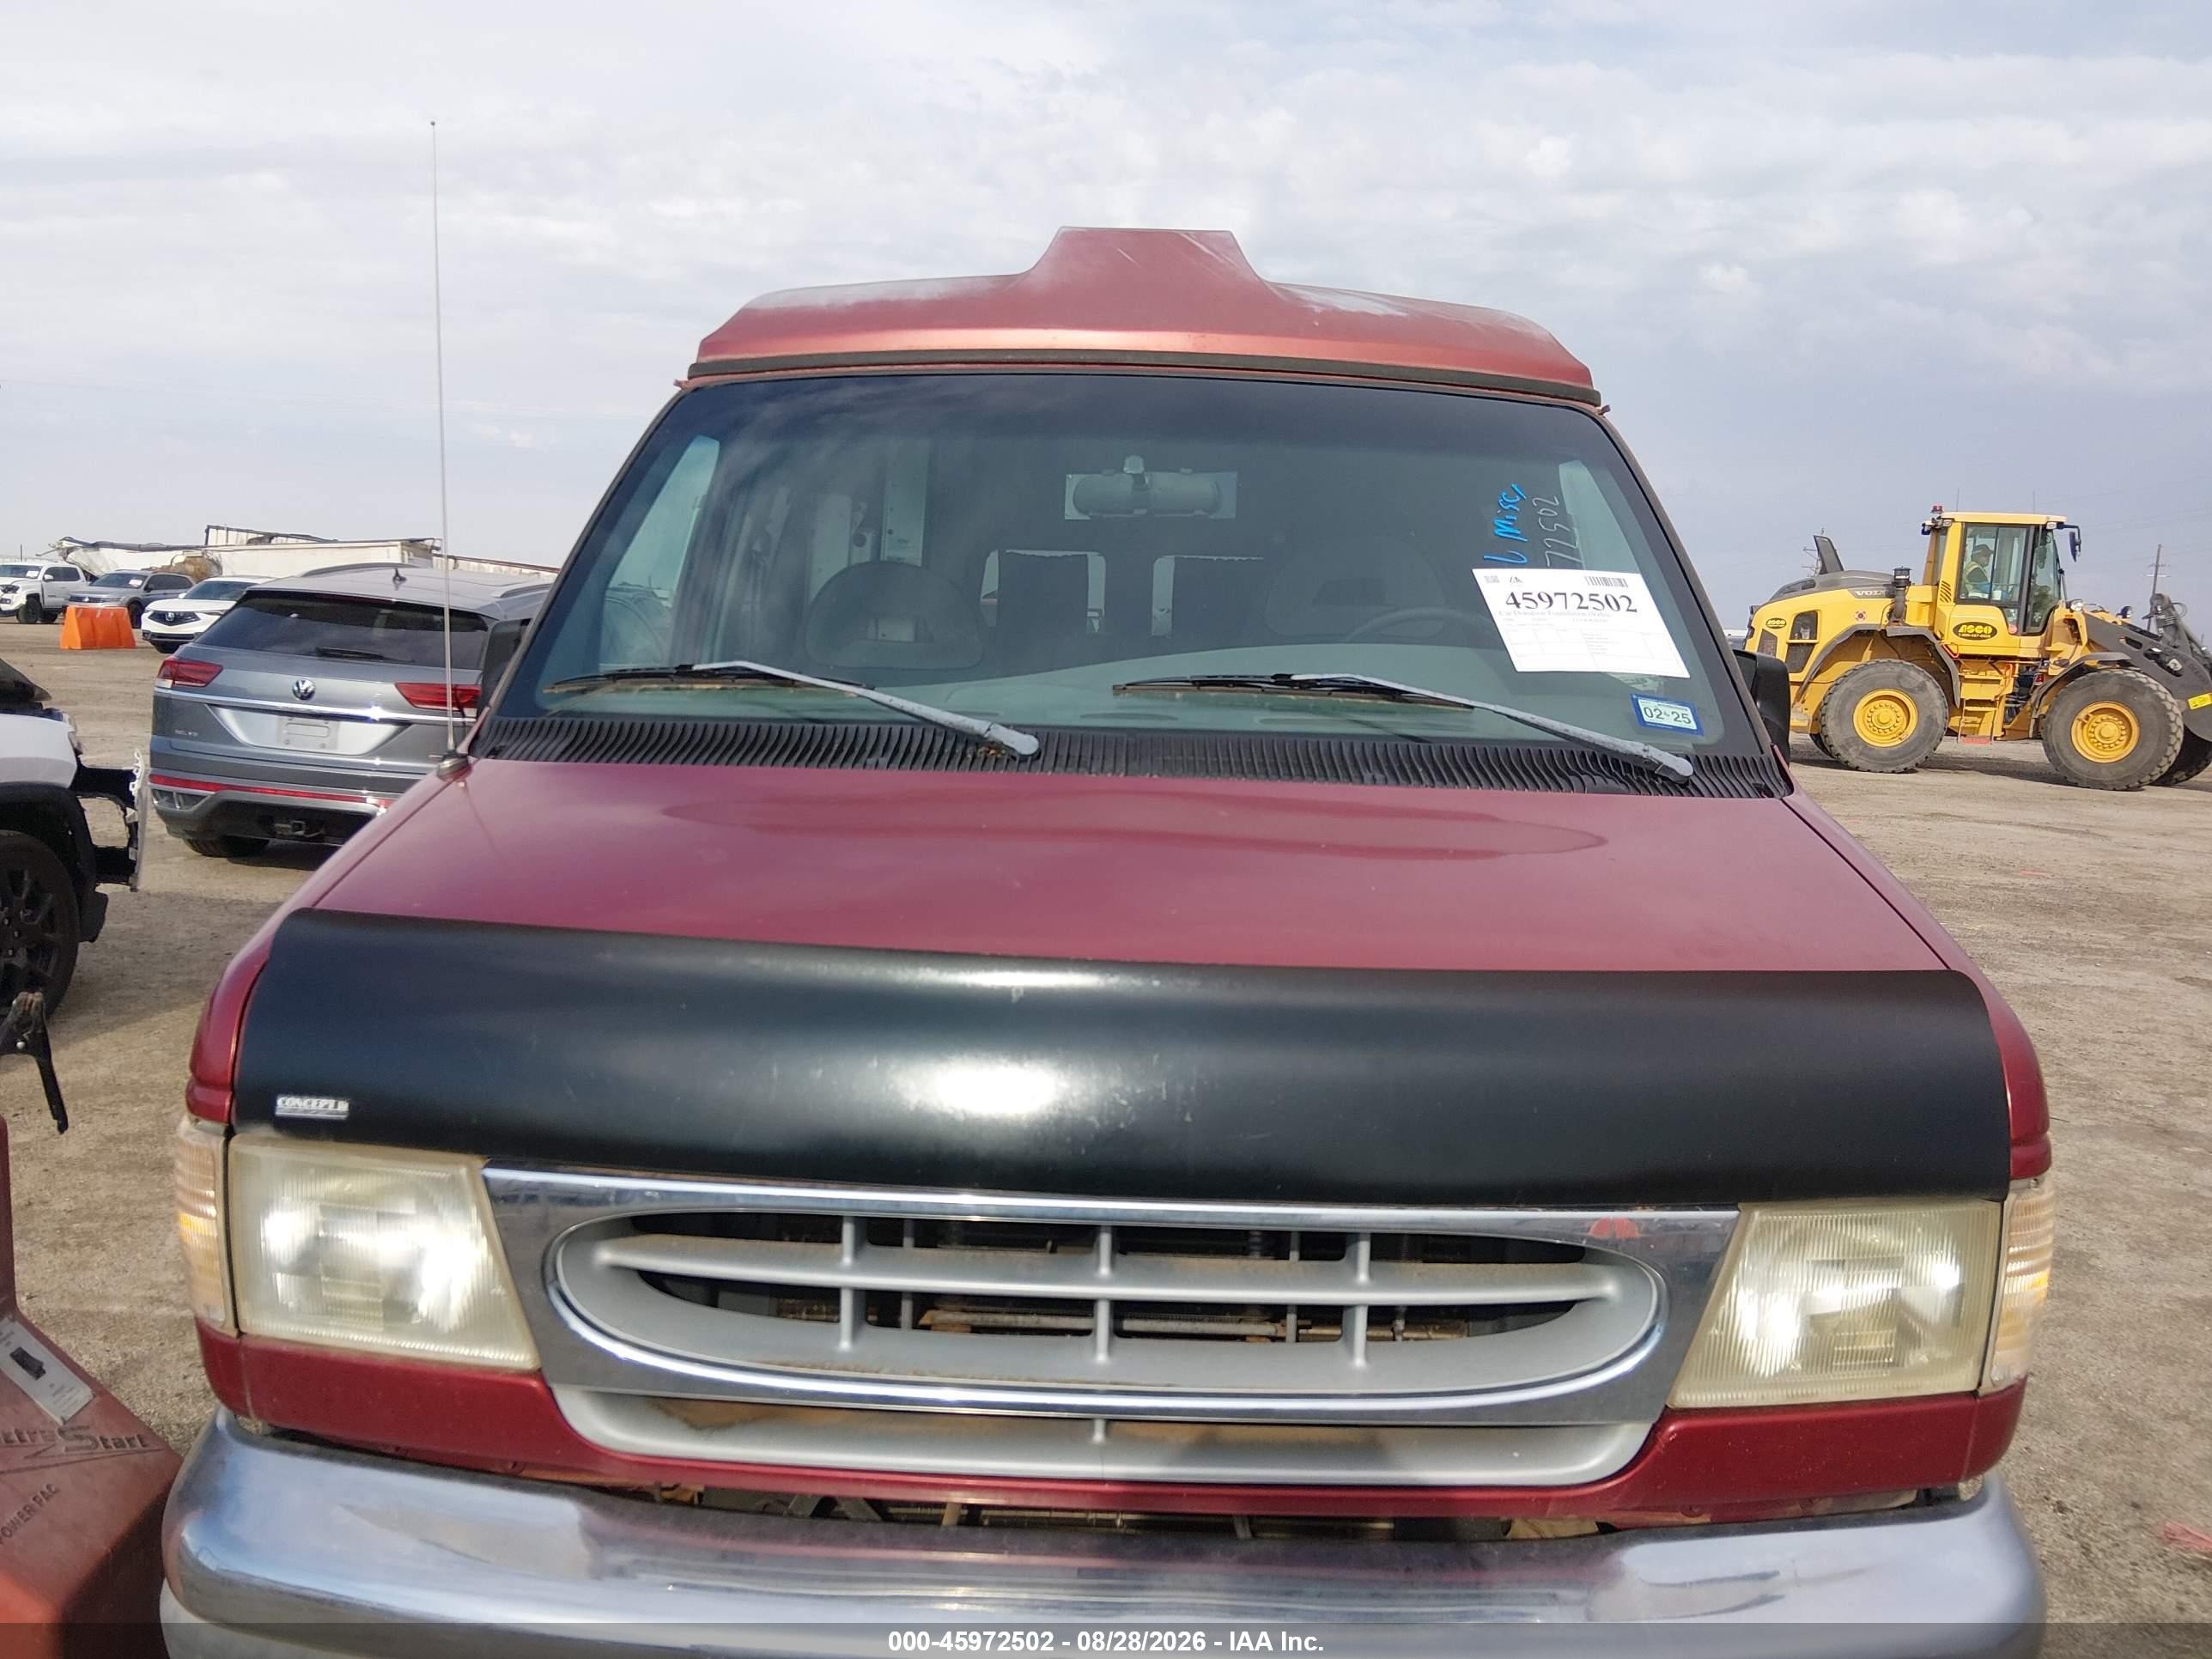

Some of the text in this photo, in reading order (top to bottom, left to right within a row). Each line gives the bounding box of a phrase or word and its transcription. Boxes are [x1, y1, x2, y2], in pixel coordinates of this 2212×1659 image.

[1505, 591, 1638, 613] 45972502
[1644, 707, 1692, 724] 02-25
[0, 1504, 35, 1543] OWER
